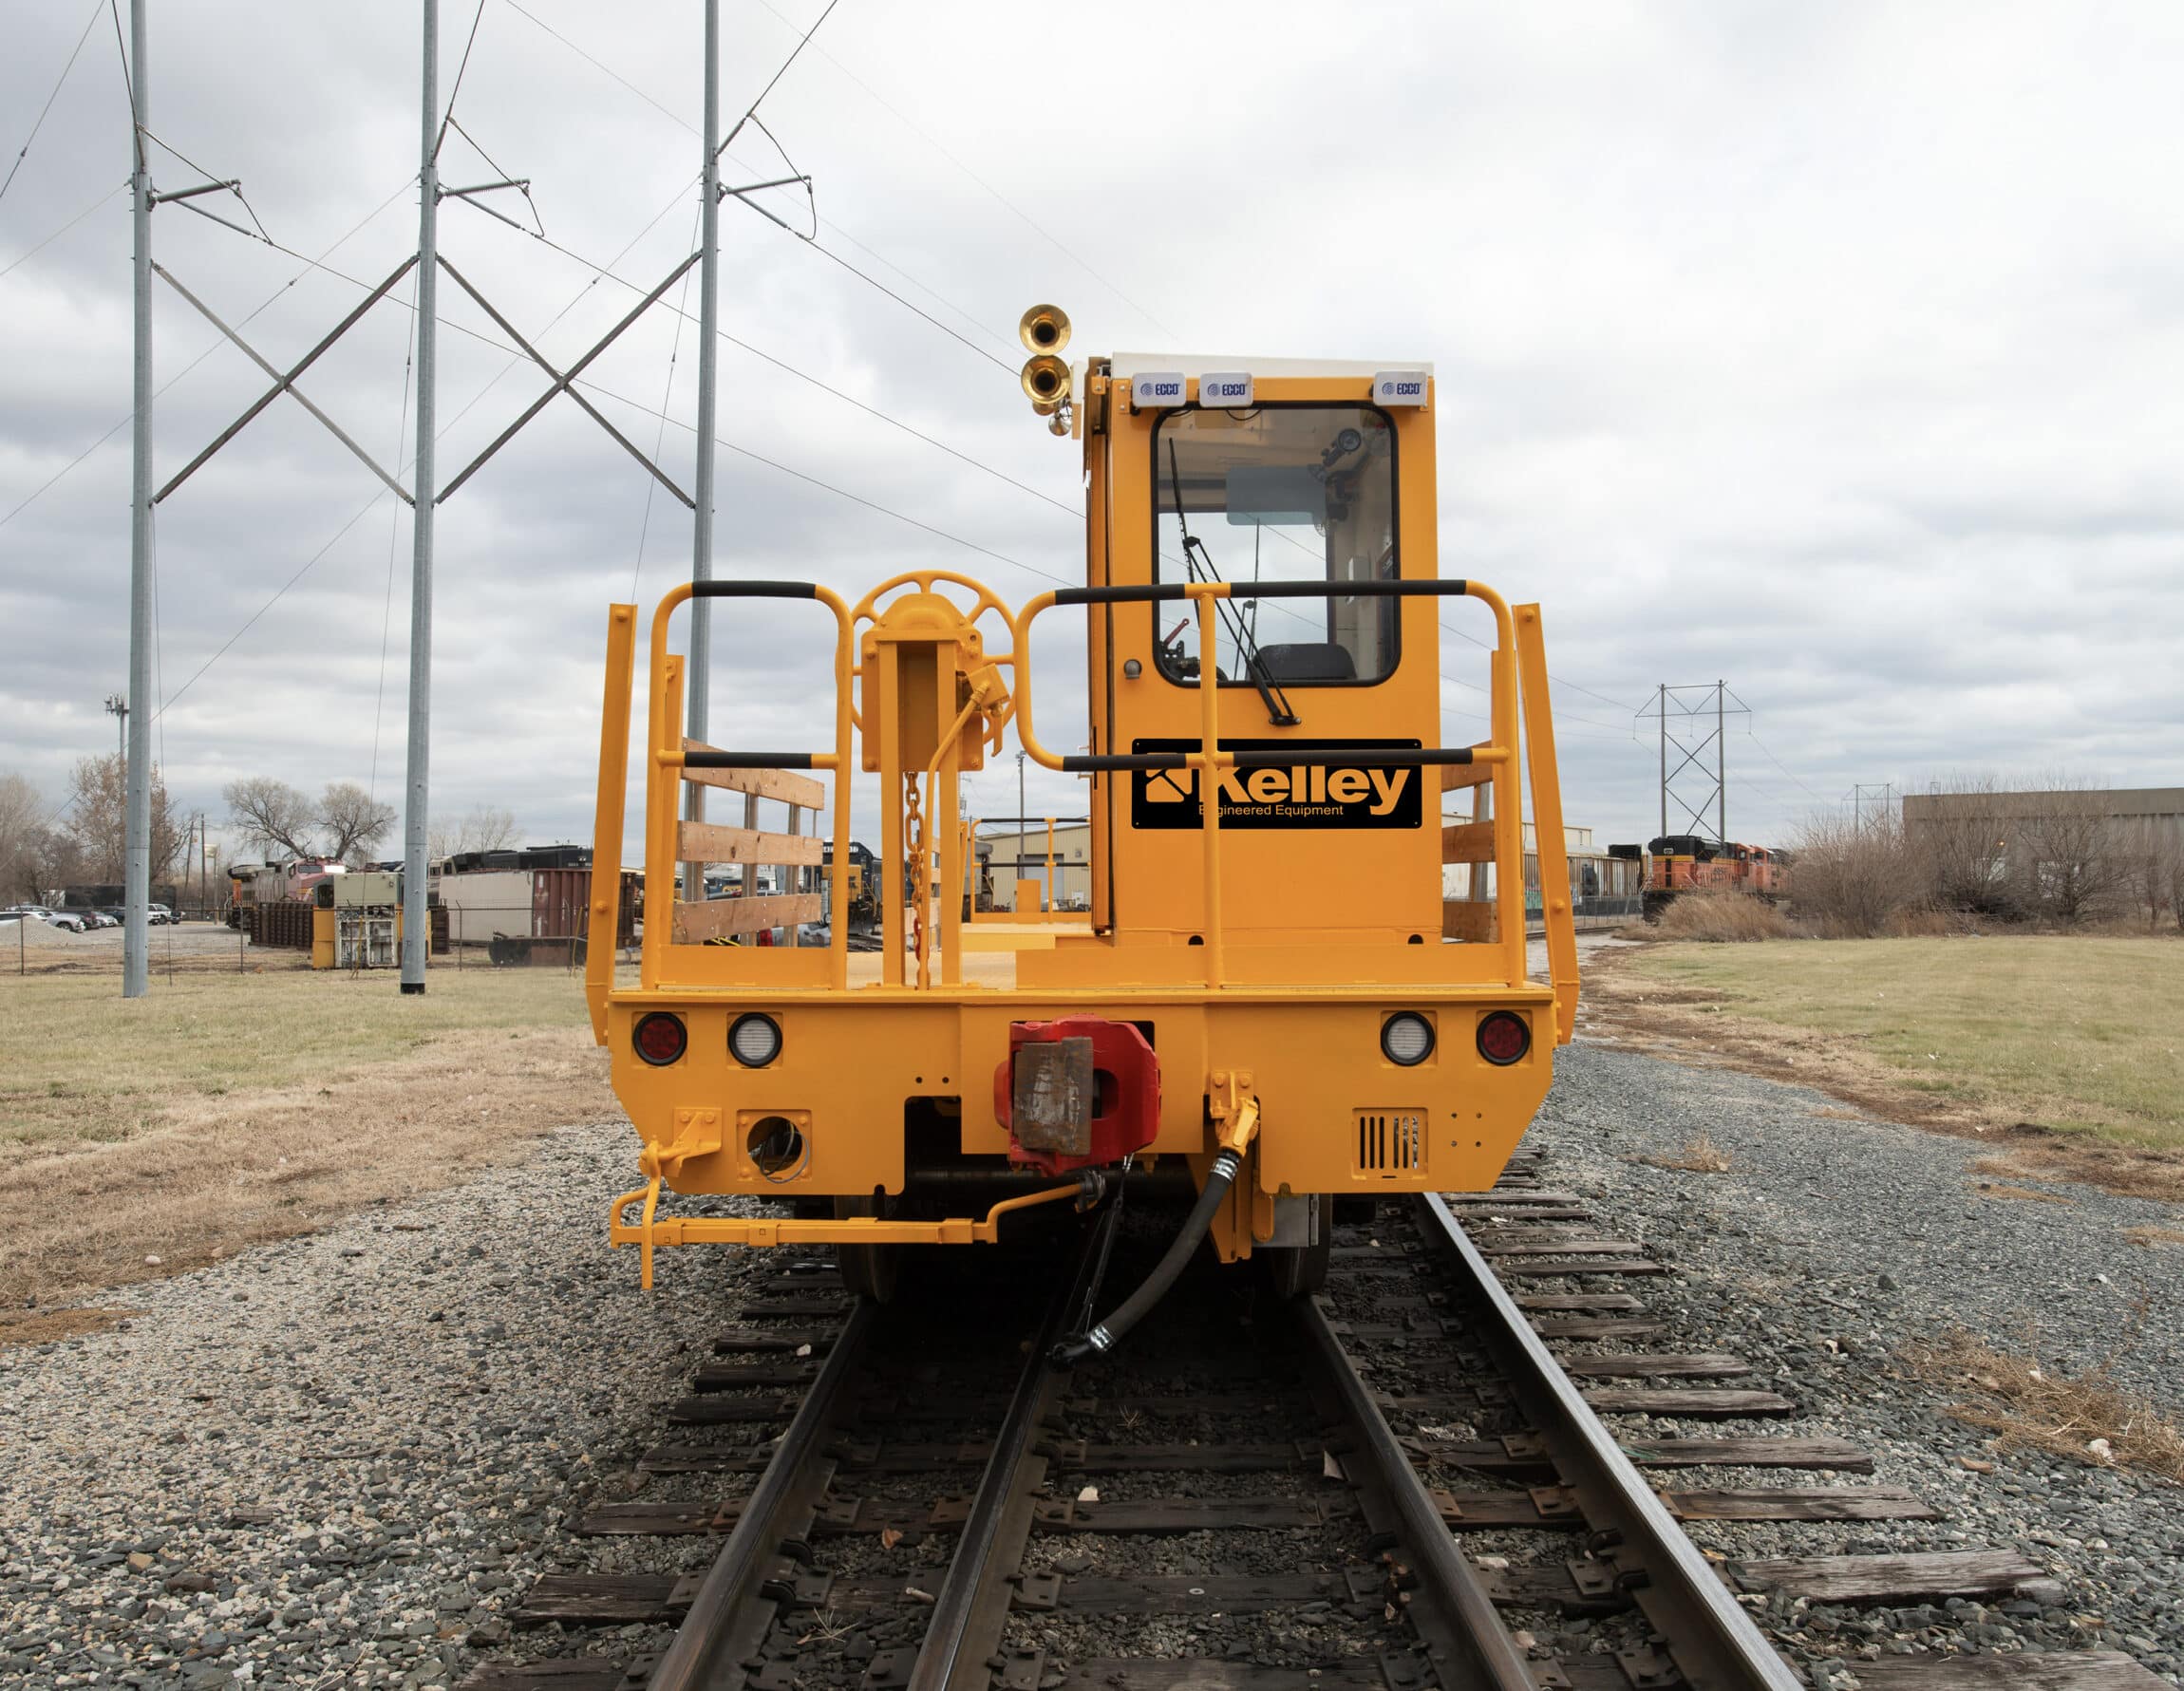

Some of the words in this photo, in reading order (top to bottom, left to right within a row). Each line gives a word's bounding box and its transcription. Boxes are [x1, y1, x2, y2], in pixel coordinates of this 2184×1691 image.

[1155, 383, 1179, 396] ECCO
[1221, 384, 1246, 396] ECCO
[1397, 383, 1420, 395] ECCO
[1198, 804, 1271, 817] Egineered
[1275, 804, 1344, 817] Equipment
